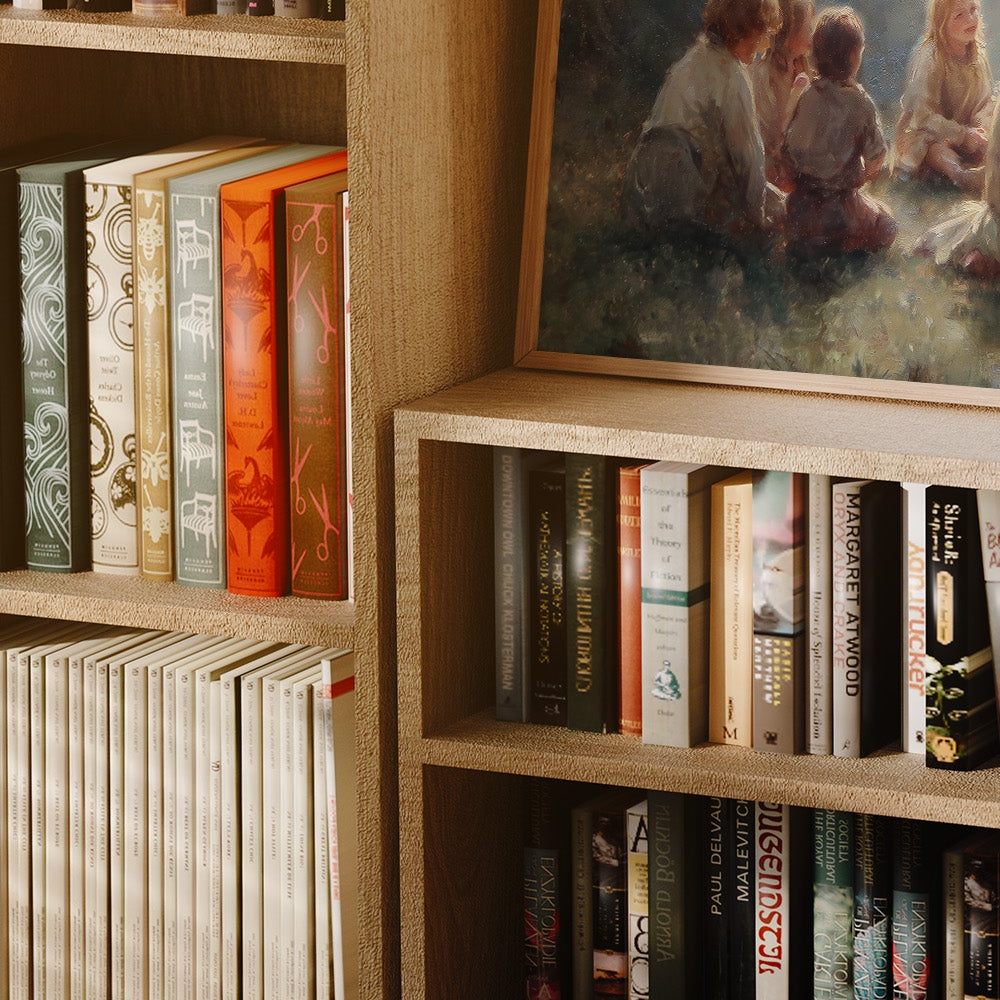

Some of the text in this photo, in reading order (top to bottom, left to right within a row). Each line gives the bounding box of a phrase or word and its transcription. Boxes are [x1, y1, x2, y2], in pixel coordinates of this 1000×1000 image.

[833, 492, 846, 670] ORYX AND CRAKE
[845, 493, 860, 698] MARGARET ATWOOD
[710, 871, 722, 916] PAUL
